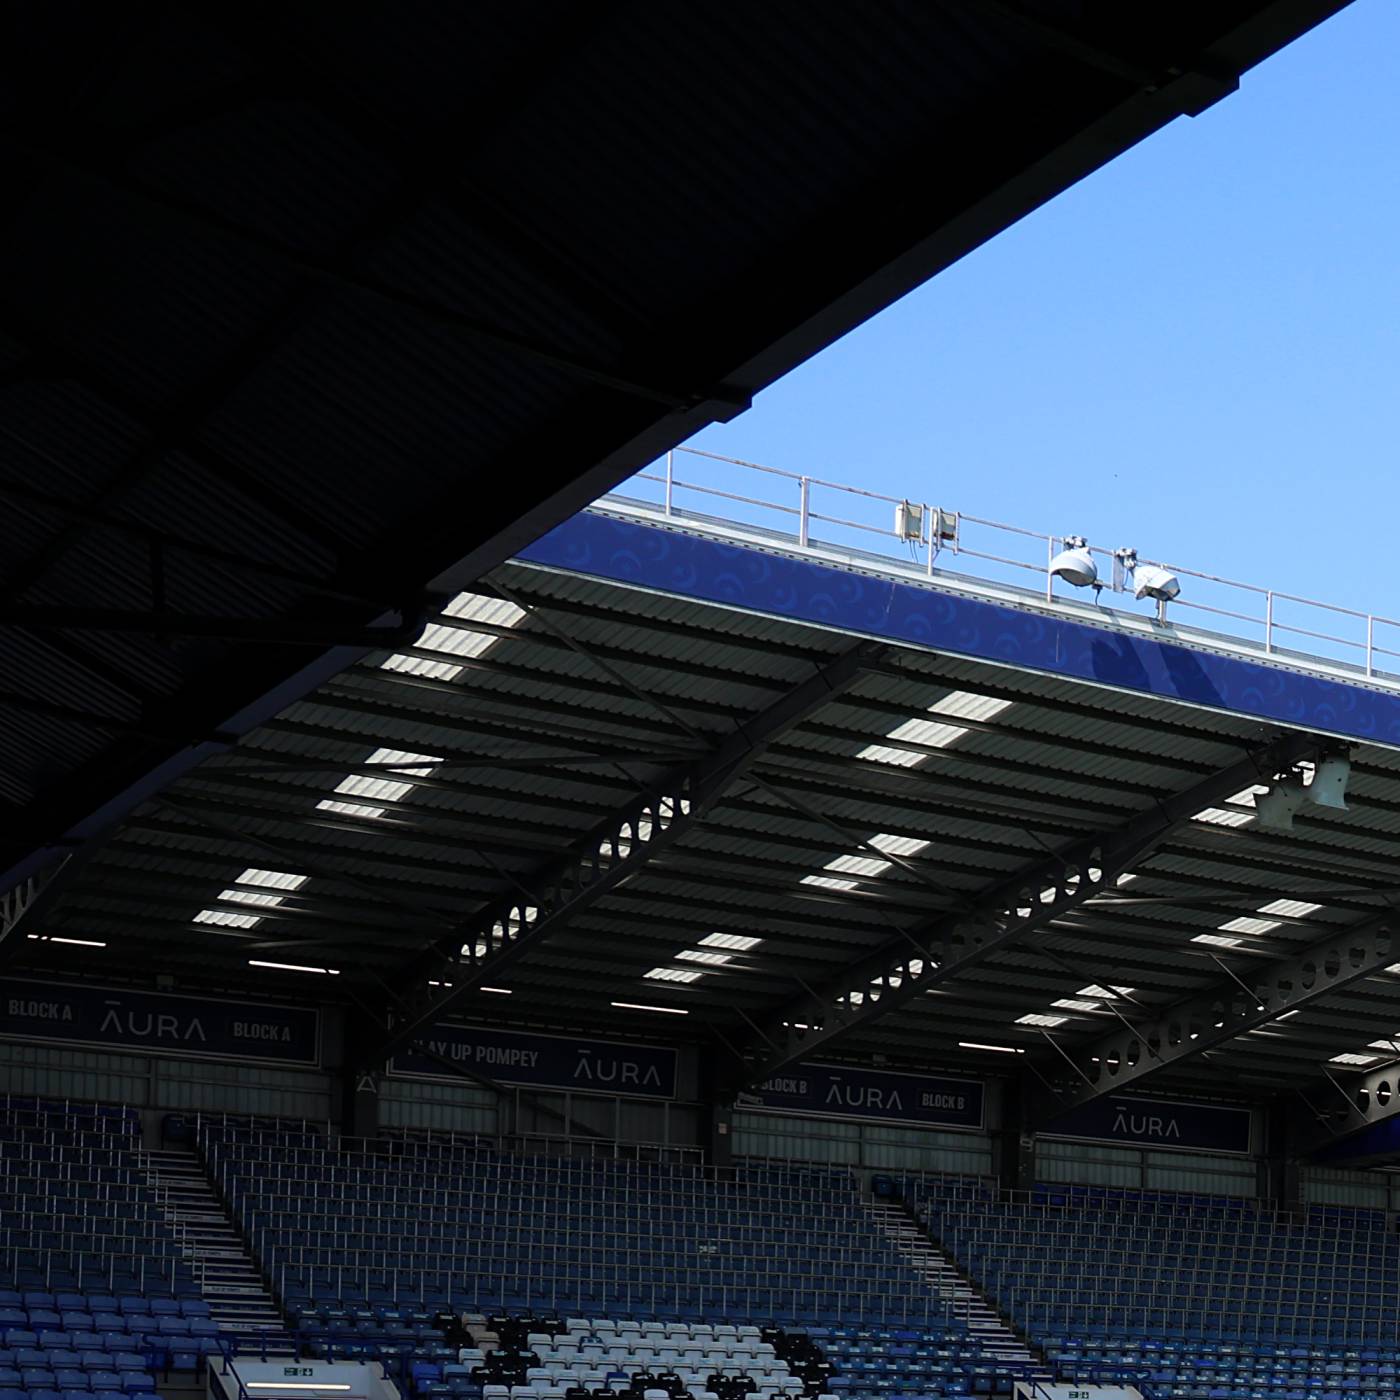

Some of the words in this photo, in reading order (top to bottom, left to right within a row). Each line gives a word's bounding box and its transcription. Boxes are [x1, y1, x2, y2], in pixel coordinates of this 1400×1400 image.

[8, 1000, 60, 1020] BLOCK
[61, 1004, 73, 1022] A
[233, 1021, 278, 1040] BLOCK
[280, 1024, 291, 1041] A
[452, 1043, 471, 1062] UP
[476, 1045, 540, 1068] POMPEY
[921, 1091, 955, 1109] BLOCK
